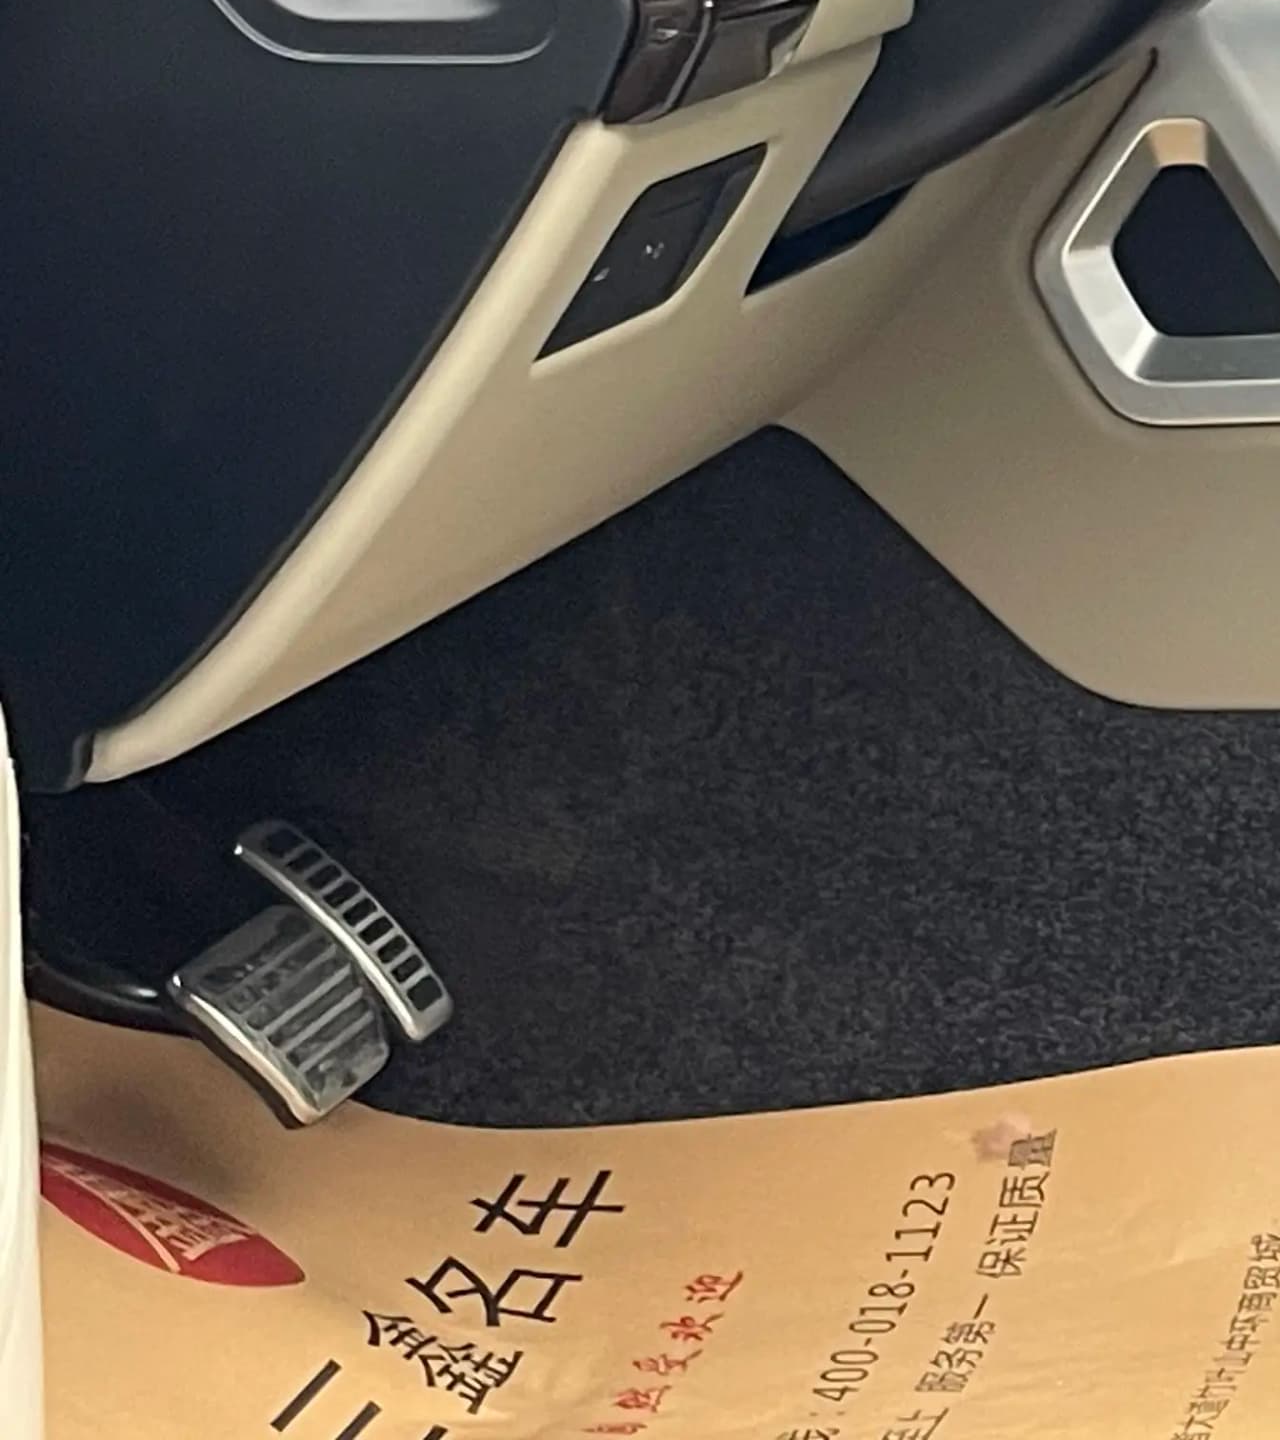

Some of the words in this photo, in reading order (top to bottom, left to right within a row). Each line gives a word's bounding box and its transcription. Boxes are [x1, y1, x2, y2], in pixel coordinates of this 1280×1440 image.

[812, 1172, 956, 1402] 400-018-1123
[975, 1128, 1058, 1278] 保证质量
